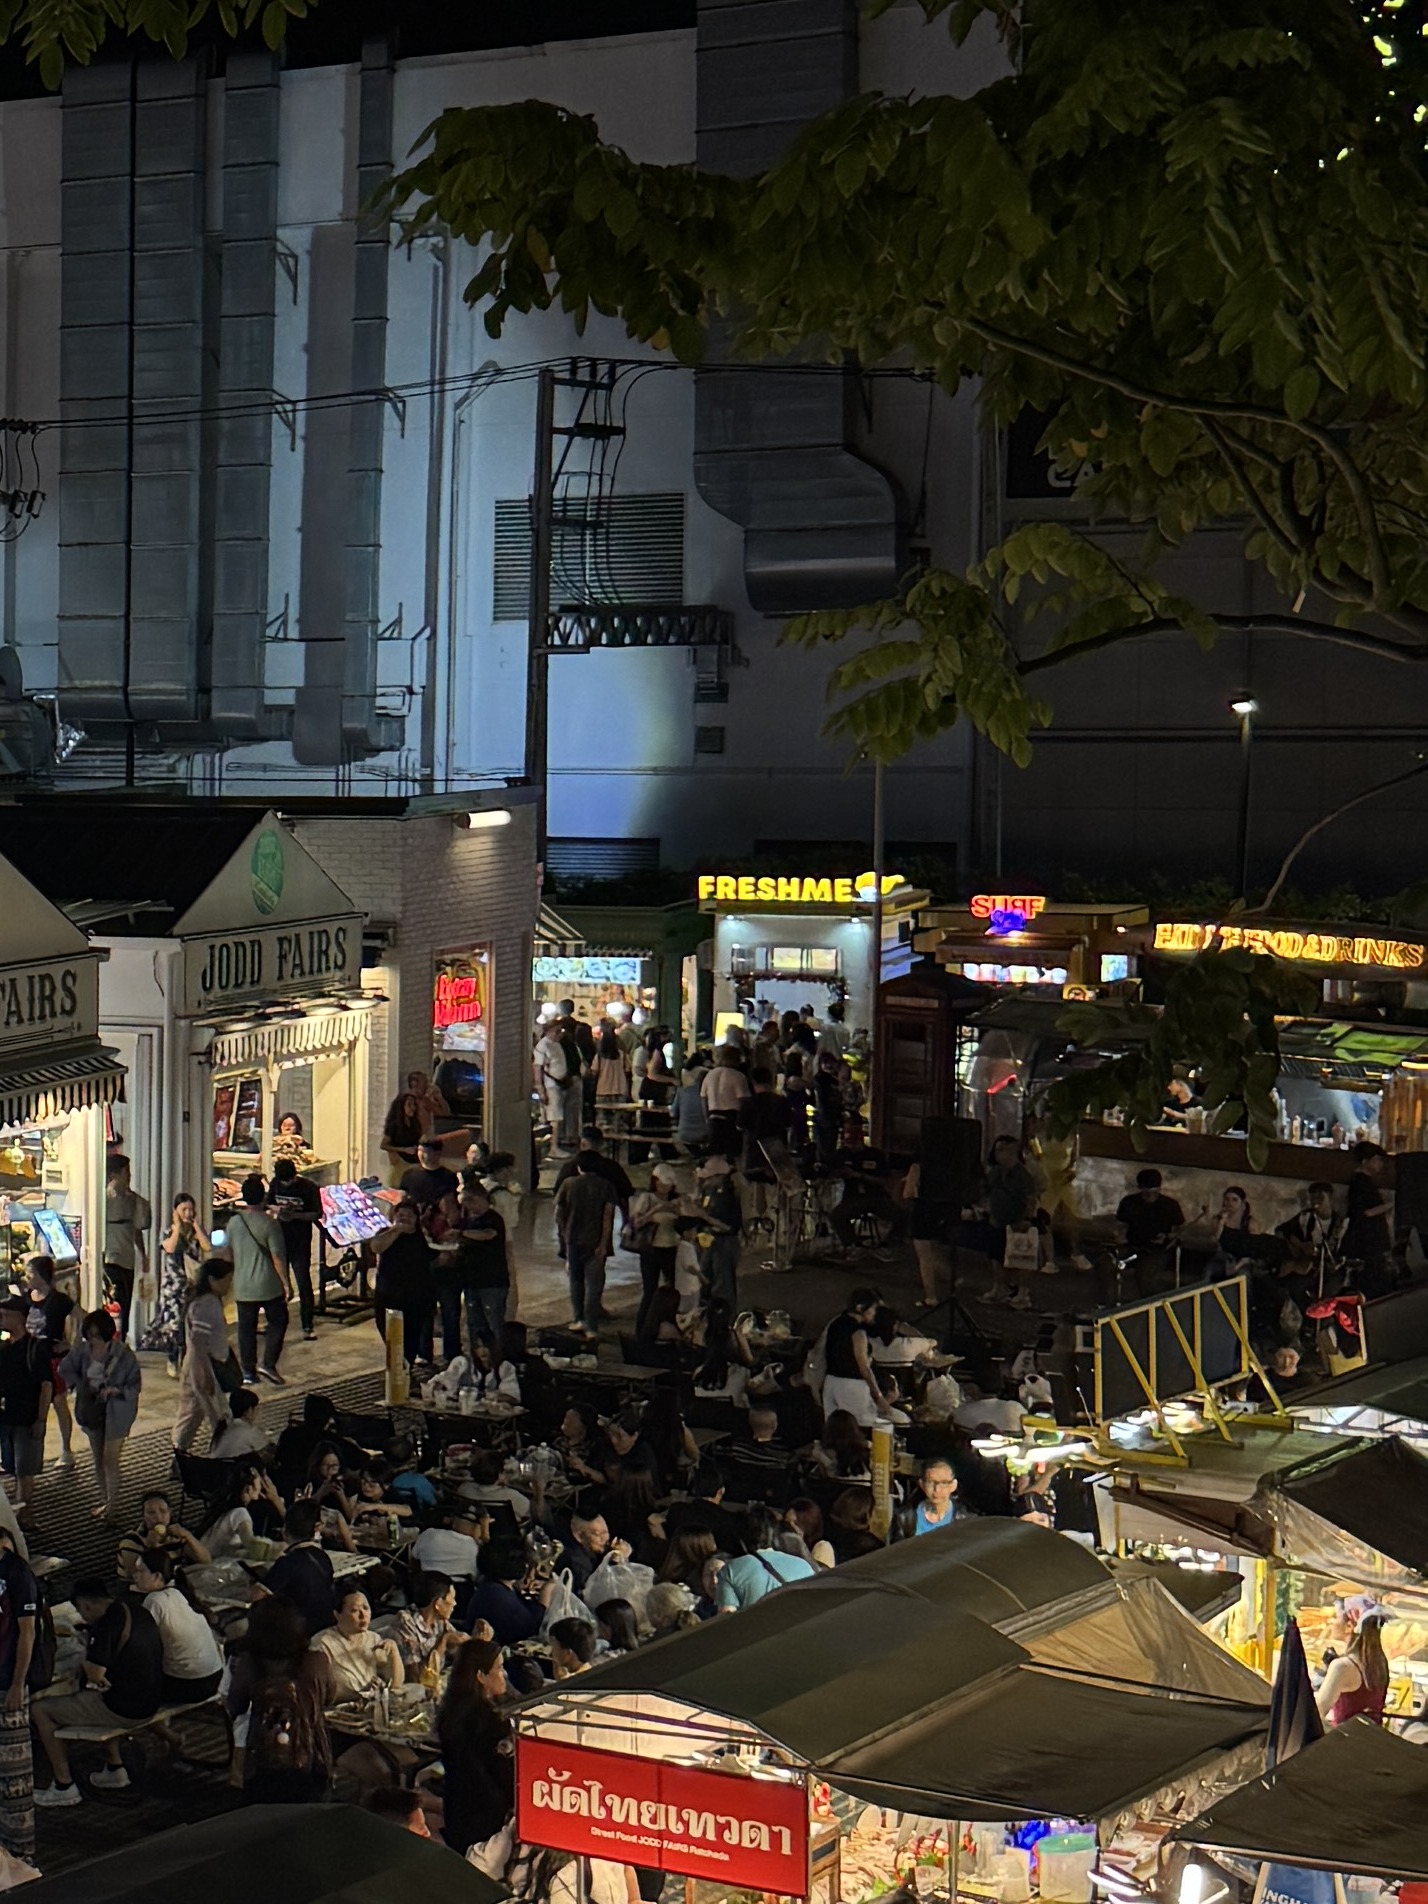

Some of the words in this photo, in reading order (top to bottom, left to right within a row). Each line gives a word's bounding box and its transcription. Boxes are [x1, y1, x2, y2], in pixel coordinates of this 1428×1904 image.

[202, 939, 262, 992] JODD
[276, 926, 346, 982] FAIRS
[532, 1766, 793, 1856] ผัดไทยเทวดา
